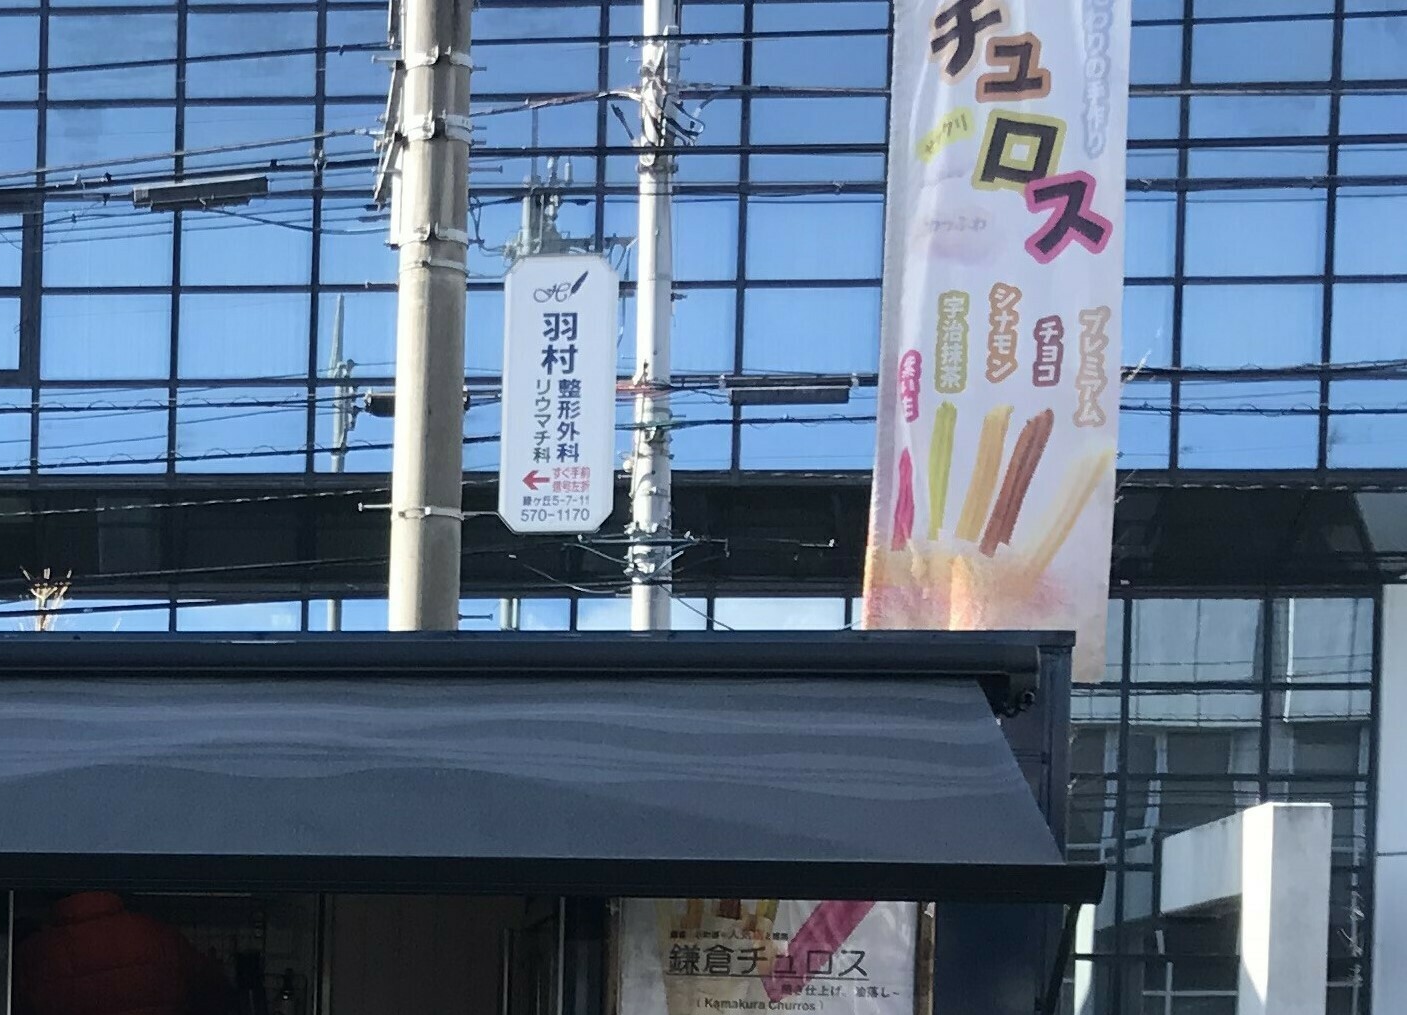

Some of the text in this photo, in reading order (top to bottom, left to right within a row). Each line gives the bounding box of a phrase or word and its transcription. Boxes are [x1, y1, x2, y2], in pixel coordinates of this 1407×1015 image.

[989, 288, 1016, 379] シナモン
[1038, 320, 1060, 383] チョコ
[533, 379, 551, 463] リウマチ科
[556, 379, 582, 463] 整形外科
[521, 508, 591, 522] 570-1170
[669, 944, 868, 977] 鎌倉チュロス
